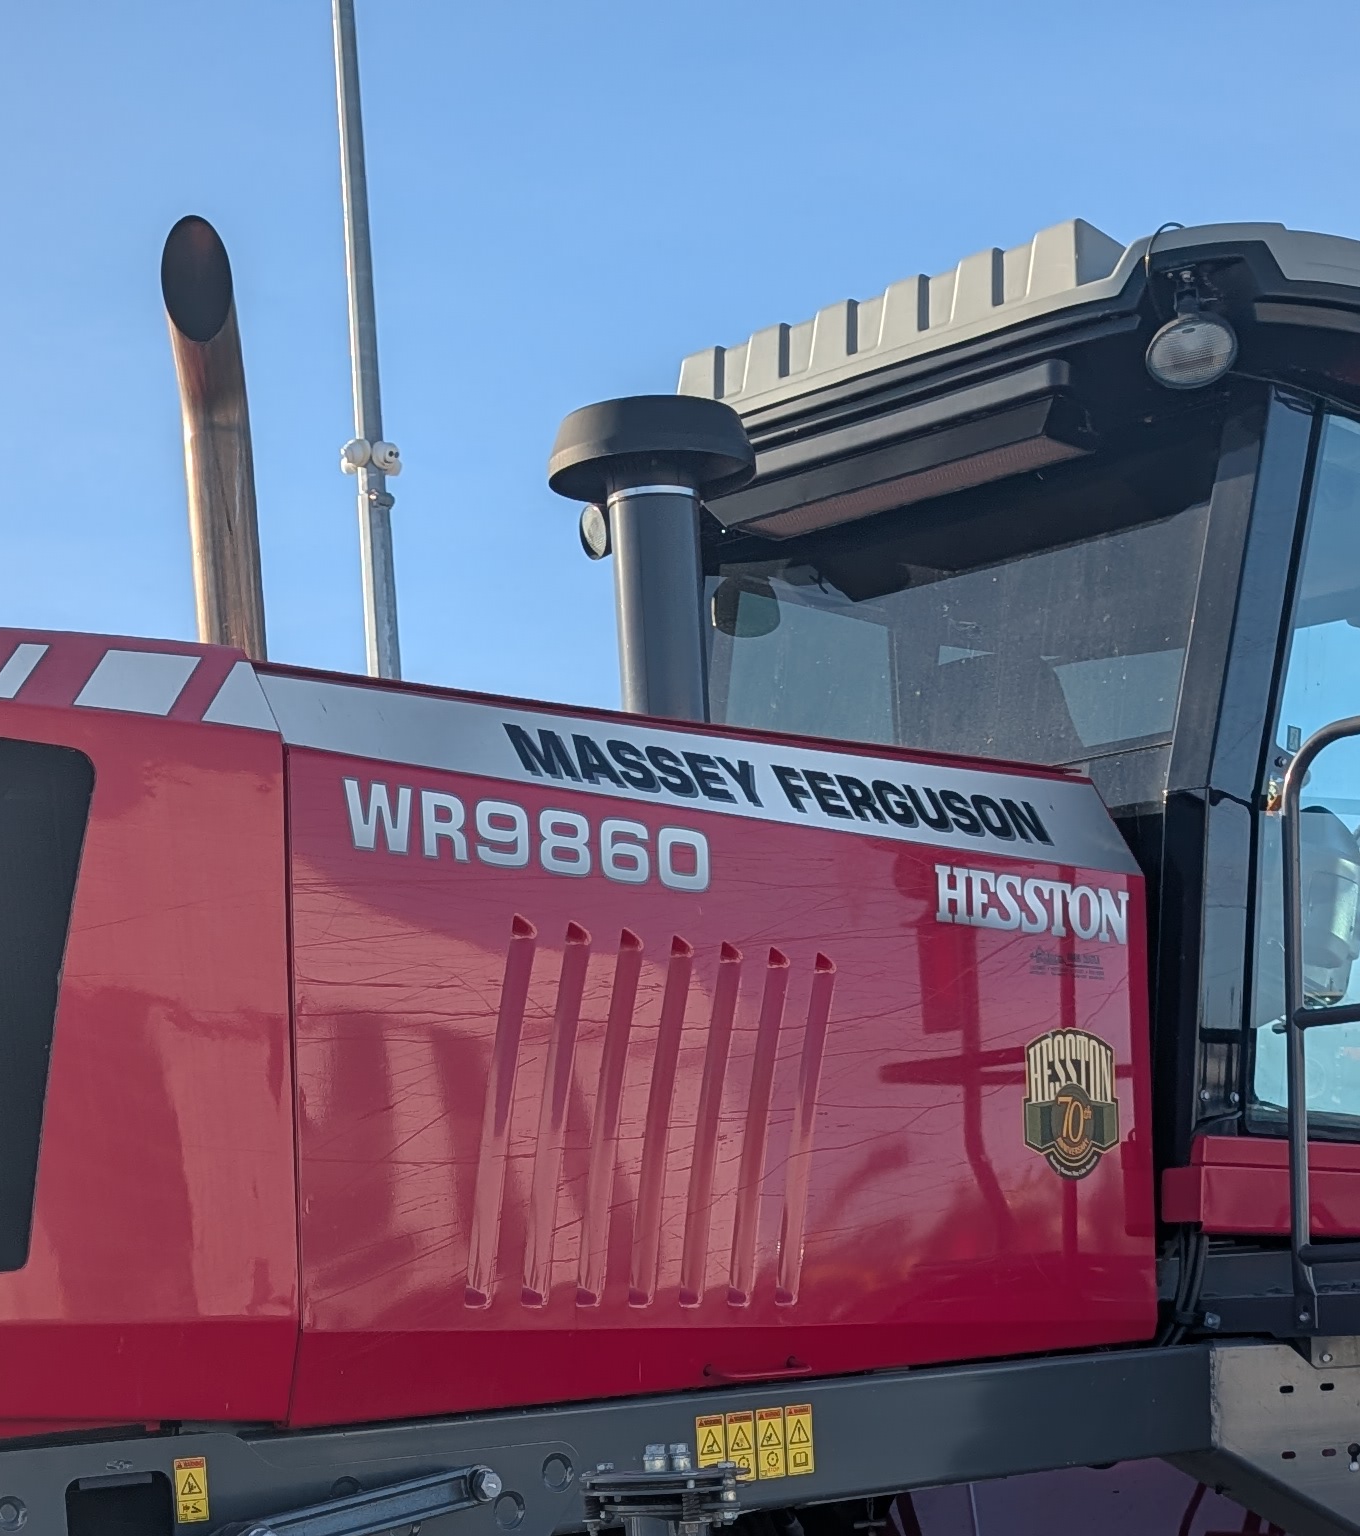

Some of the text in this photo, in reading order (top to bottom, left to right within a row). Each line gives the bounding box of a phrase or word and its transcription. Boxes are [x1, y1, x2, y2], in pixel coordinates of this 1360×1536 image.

[342, 776, 711, 893] WR9860
[502, 723, 1055, 847] MASSEY FERGUSON
[934, 863, 1130, 945] HESSTON
[1029, 1033, 1111, 1103] HESSTON
